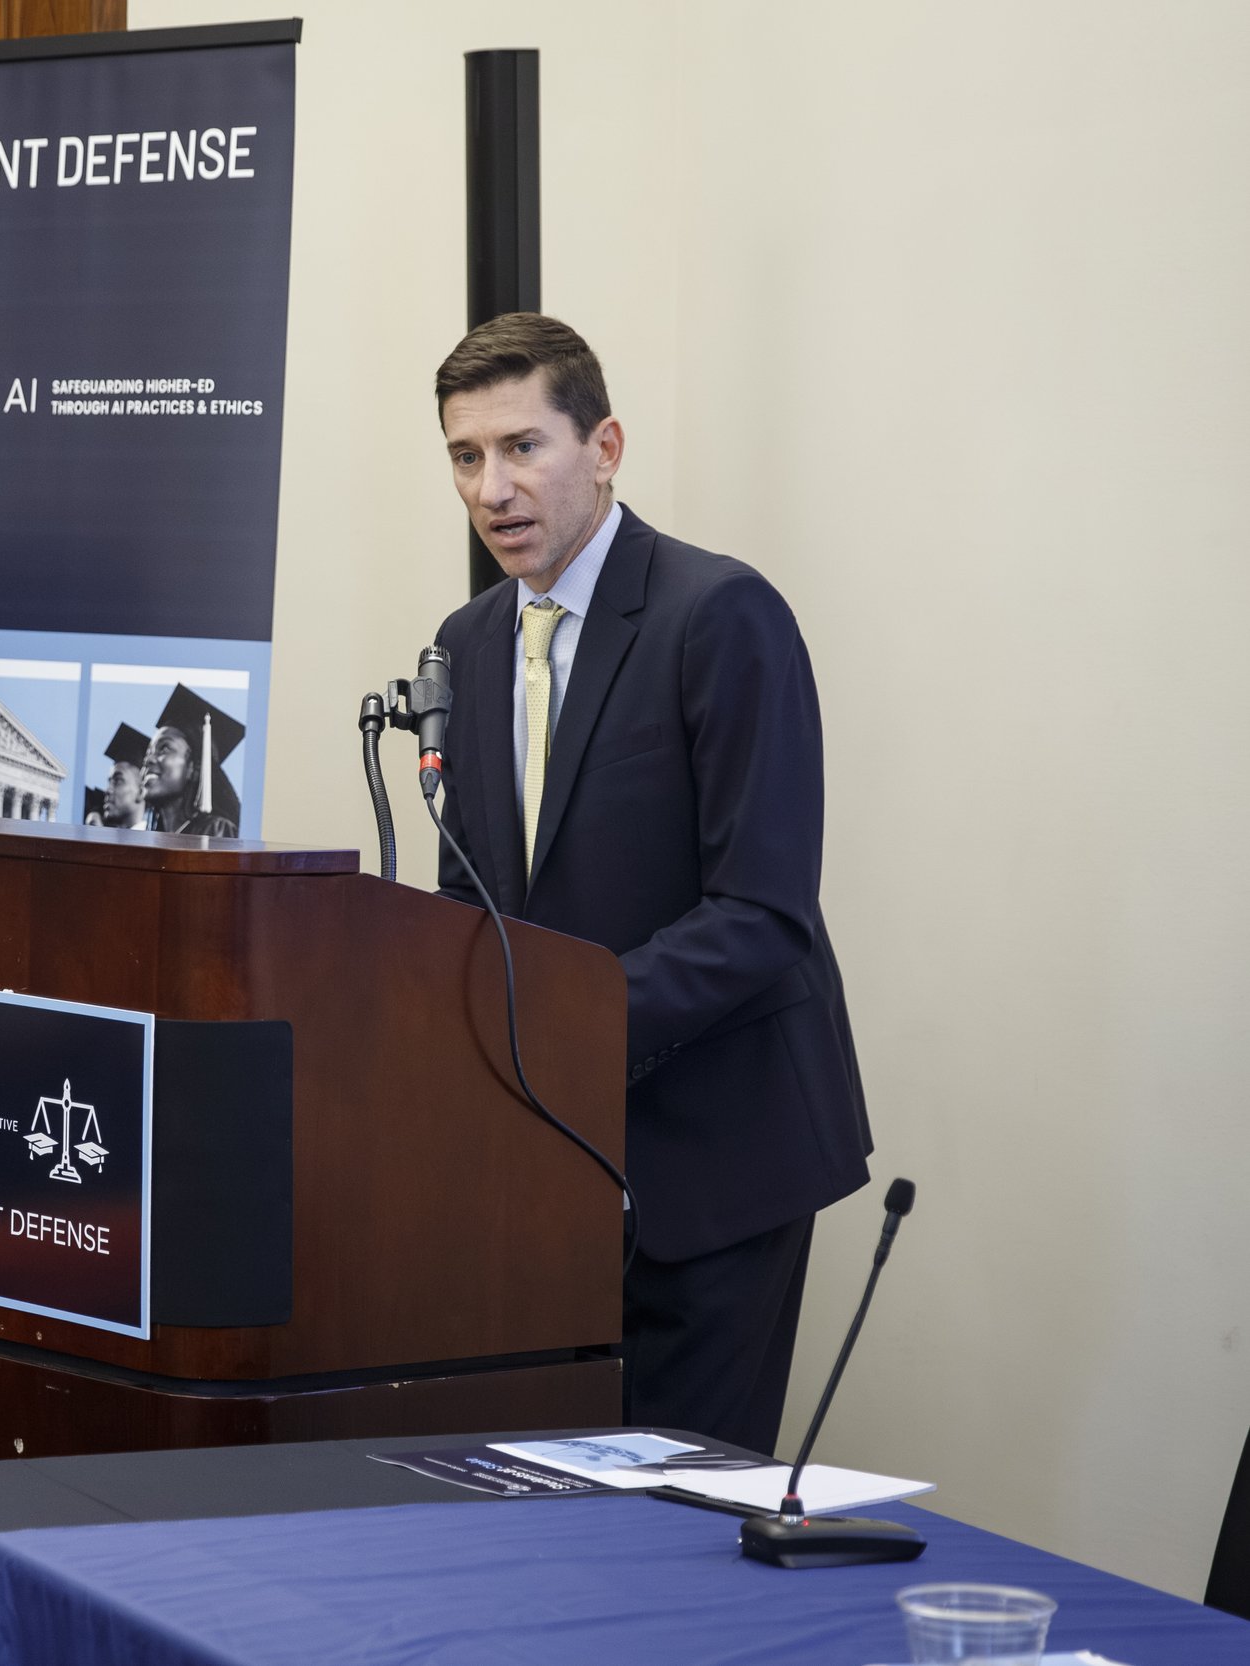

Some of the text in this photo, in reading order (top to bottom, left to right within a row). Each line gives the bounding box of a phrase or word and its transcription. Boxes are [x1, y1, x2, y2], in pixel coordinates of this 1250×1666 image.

[56, 126, 258, 187] DEFENSE
[3, 377, 38, 414] AI
[51, 378, 215, 395] SAFEGUARDING HIGHER-ED
[50, 399, 264, 416] THROUGH AI PRACTICES & ETHICS
[10, 1209, 110, 1255] DEFENSE
